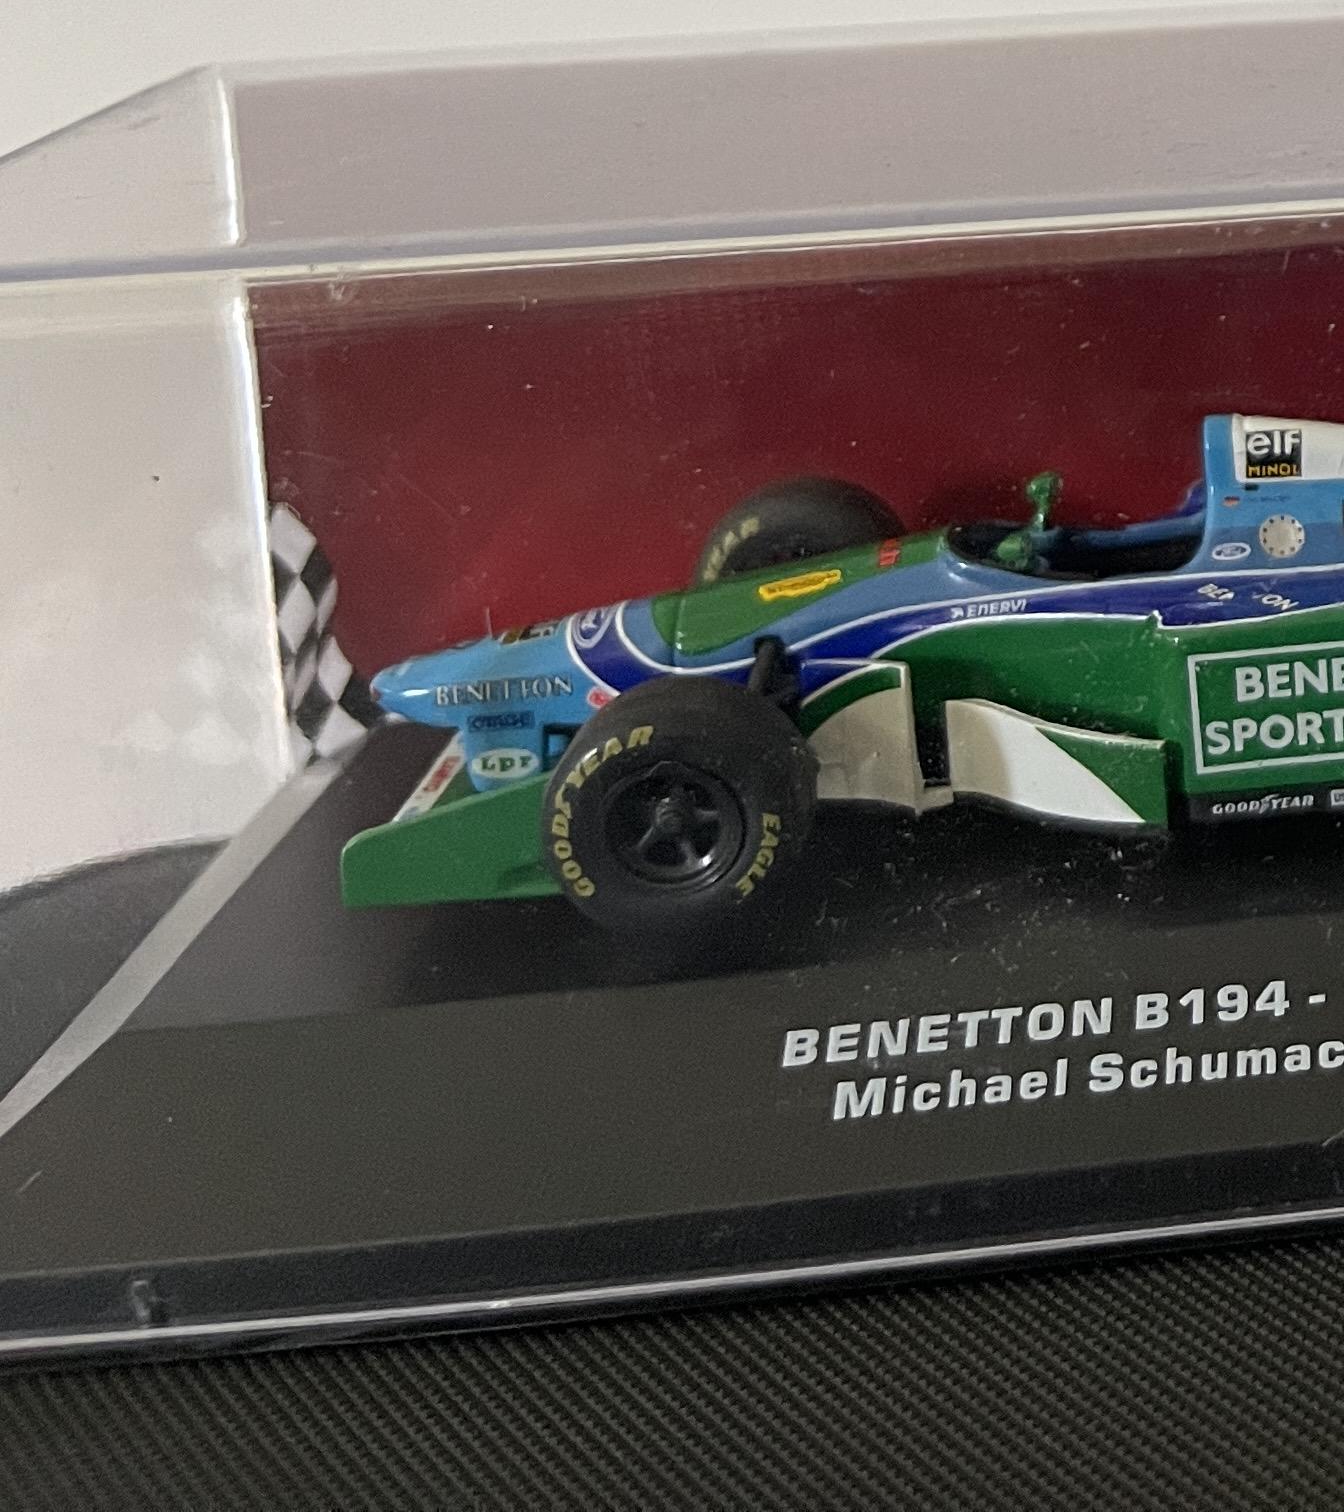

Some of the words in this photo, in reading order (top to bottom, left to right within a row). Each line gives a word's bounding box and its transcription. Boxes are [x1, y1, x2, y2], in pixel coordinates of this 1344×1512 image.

[1246, 428, 1301, 456] elf
[735, 812, 782, 898] EAGLE
[780, 997, 1114, 1069] BENETTON
[1134, 979, 1291, 1031] B194
[1307, 993, 1327, 1006] -
[832, 1057, 1069, 1122] Michael
